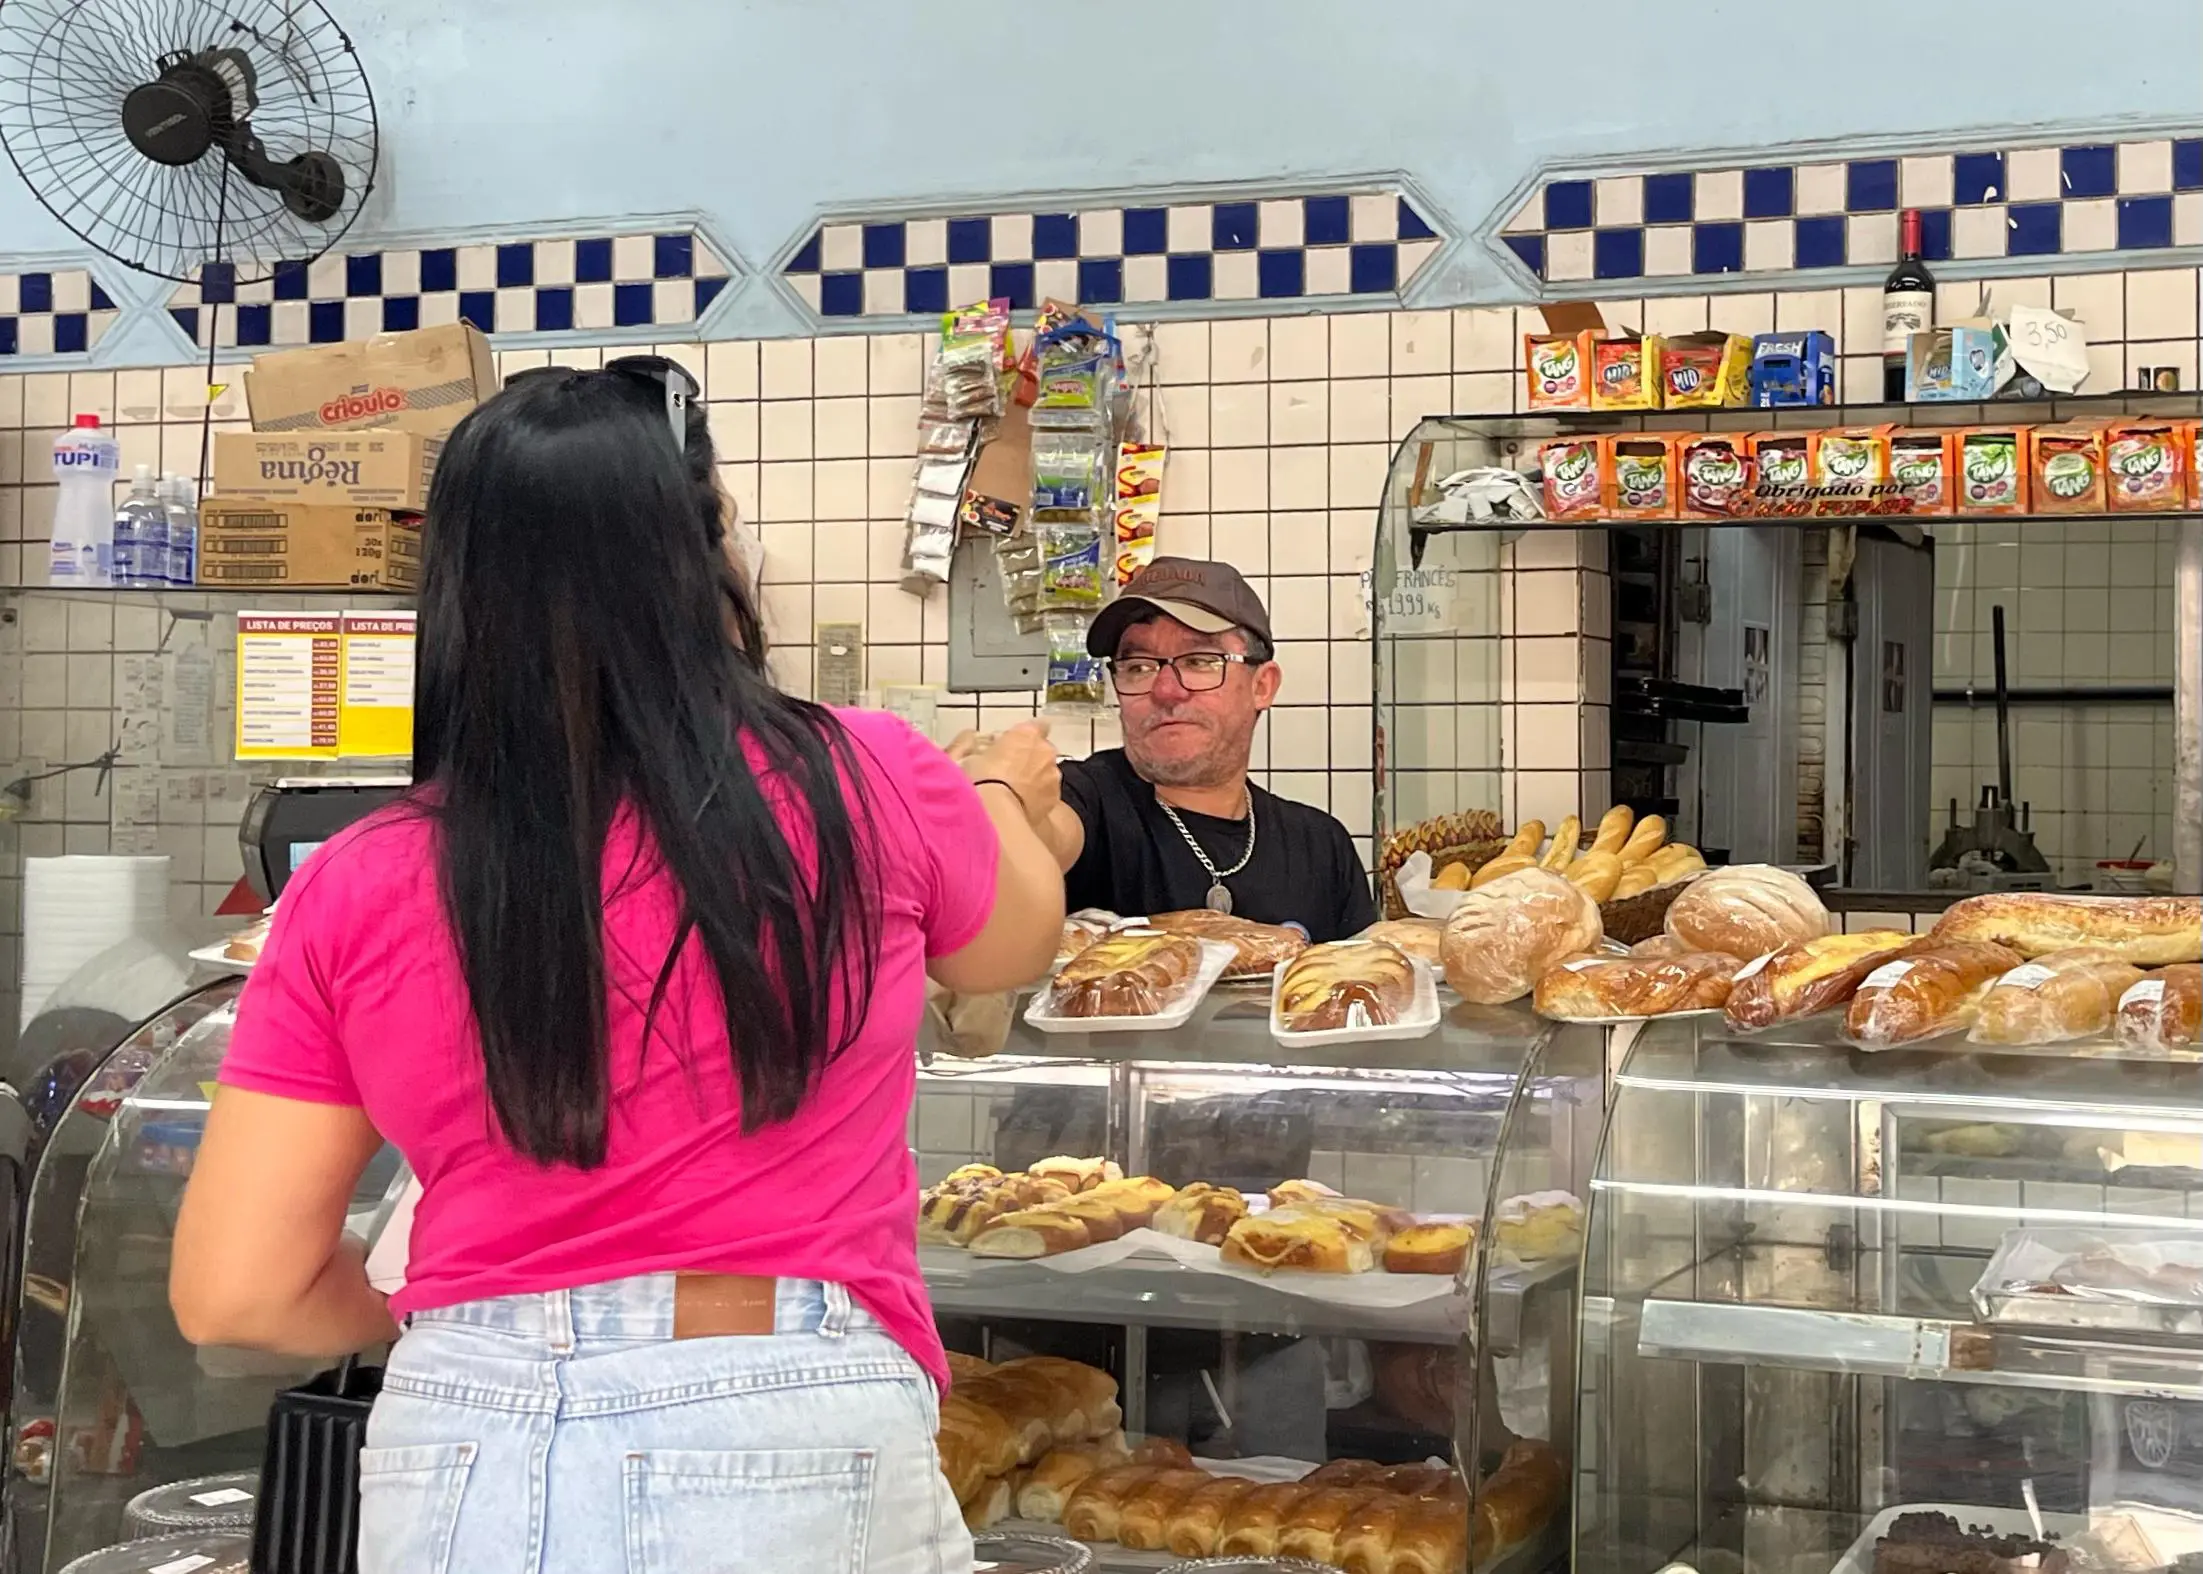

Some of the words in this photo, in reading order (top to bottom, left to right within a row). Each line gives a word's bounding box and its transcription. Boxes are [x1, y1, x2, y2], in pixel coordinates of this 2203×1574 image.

[1758, 341, 1803, 355] FRESH
[1541, 360, 1574, 378] TANG
[1605, 364, 1632, 382] MID
[1672, 367, 1700, 391] MID
[322, 391, 400, 418] crioulo
[1556, 457, 1587, 480] TANG
[1829, 456, 1867, 475] TANG
[1970, 460, 2006, 481] TANG
[2123, 453, 2160, 474] TANG
[1627, 471, 1661, 490] TANG
[1702, 466, 1735, 485] TANG
[1768, 465, 1801, 483] TANG
[1901, 463, 1937, 485] TANG
[2054, 470, 2090, 497] TANG
[1755, 482, 1863, 499] Obrigado
[1868, 483, 1911, 497] por
[355, 507, 384, 523] dori
[351, 570, 381, 585] dori
[246, 620, 276, 630] LISTA
[278, 620, 291, 630] DE
[293, 620, 333, 632] PREÇOS
[351, 621, 379, 631] LISTA
[381, 621, 394, 631] DE
